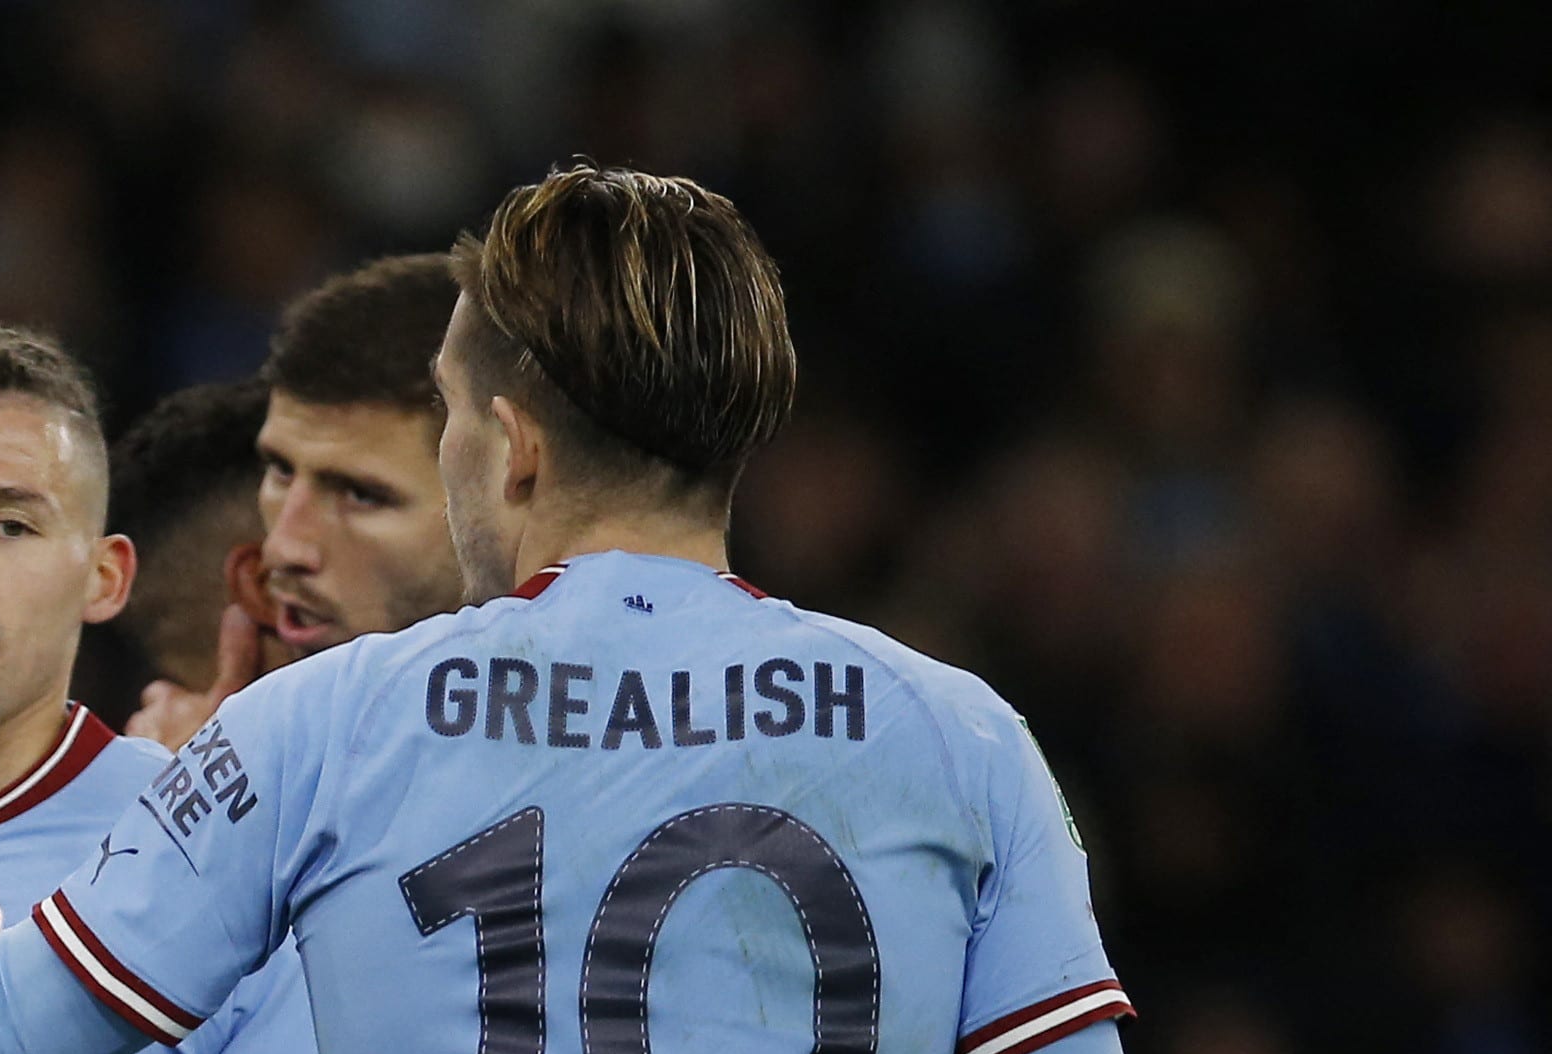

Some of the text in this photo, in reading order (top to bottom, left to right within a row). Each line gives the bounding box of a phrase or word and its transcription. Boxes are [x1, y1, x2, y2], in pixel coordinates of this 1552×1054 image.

[425, 656, 866, 750] GREALISH
[151, 756, 212, 837] IRE
[188, 720, 258, 824] XEN
